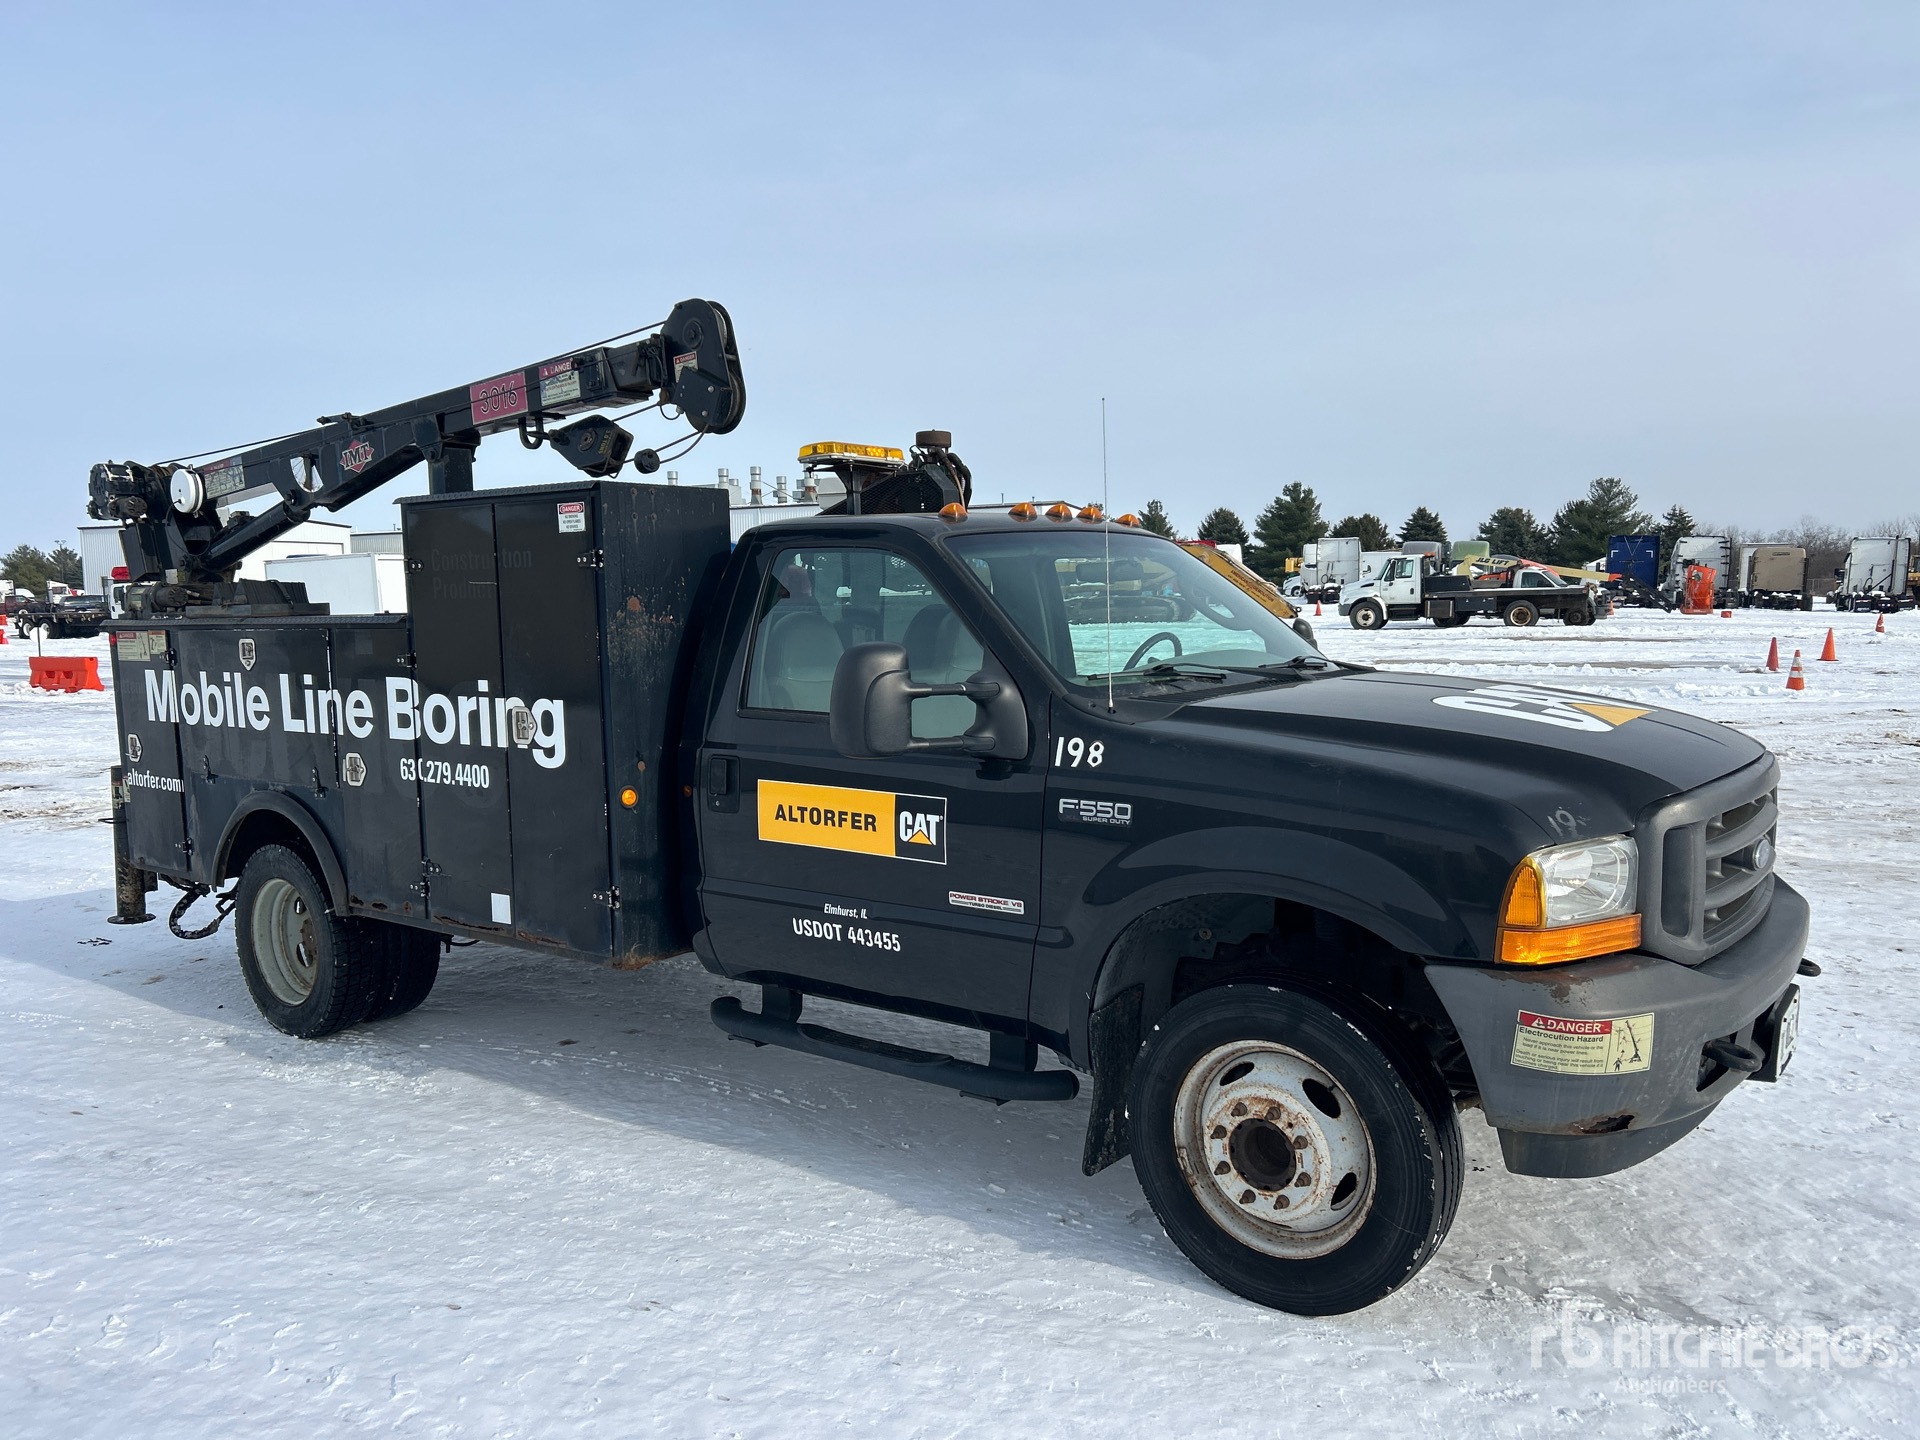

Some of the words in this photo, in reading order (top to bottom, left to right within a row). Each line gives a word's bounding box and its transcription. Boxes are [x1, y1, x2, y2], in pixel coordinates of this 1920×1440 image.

[479, 380, 518, 414] 3016
[342, 442, 371, 469] IMT
[561, 505, 580, 513] DANGER
[431, 547, 532, 572] Constrution
[144, 669, 271, 731] Mobile
[280, 673, 374, 739] Line
[386, 677, 566, 769] Boring
[1054, 736, 1105, 768] 198
[128, 768, 184, 792] altorfer.com
[775, 804, 877, 832] ALTORFER
[900, 811, 939, 846] CAT
[824, 904, 858, 918] Elmhurst,
[860, 908, 868, 919] IL
[950, 892, 976, 901] POWER
[978, 896, 1008, 906] STROKE
[792, 918, 842, 942] USDOT
[848, 926, 901, 952] 443455
[1520, 1026, 1574, 1042] Electrocution
[1547, 1020, 1602, 1033] DANGER
